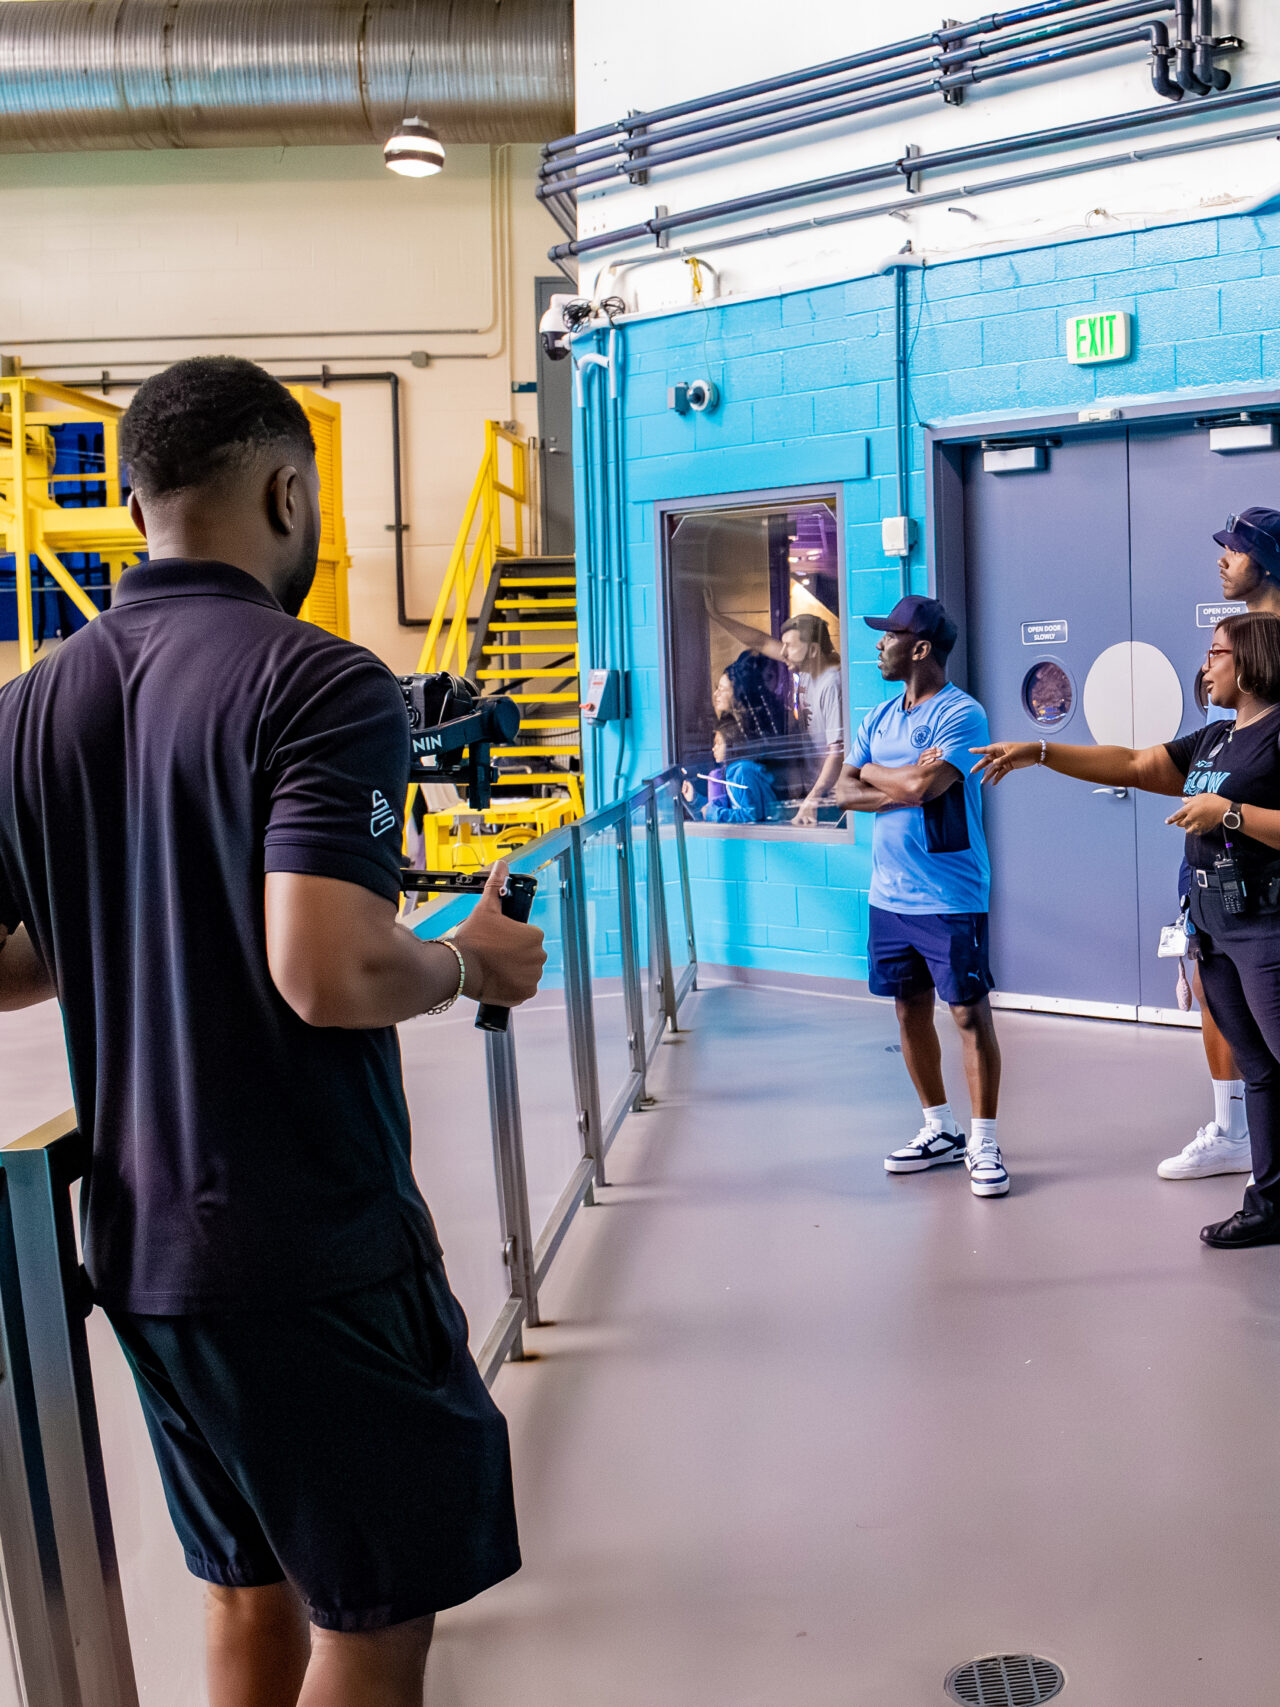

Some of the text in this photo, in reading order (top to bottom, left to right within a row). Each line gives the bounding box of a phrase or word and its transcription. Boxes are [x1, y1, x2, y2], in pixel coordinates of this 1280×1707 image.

[1076, 315, 1116, 358] EXIT
[1203, 606, 1241, 615] OPEN DOOR
[1034, 633, 1056, 641] SLOWLY
